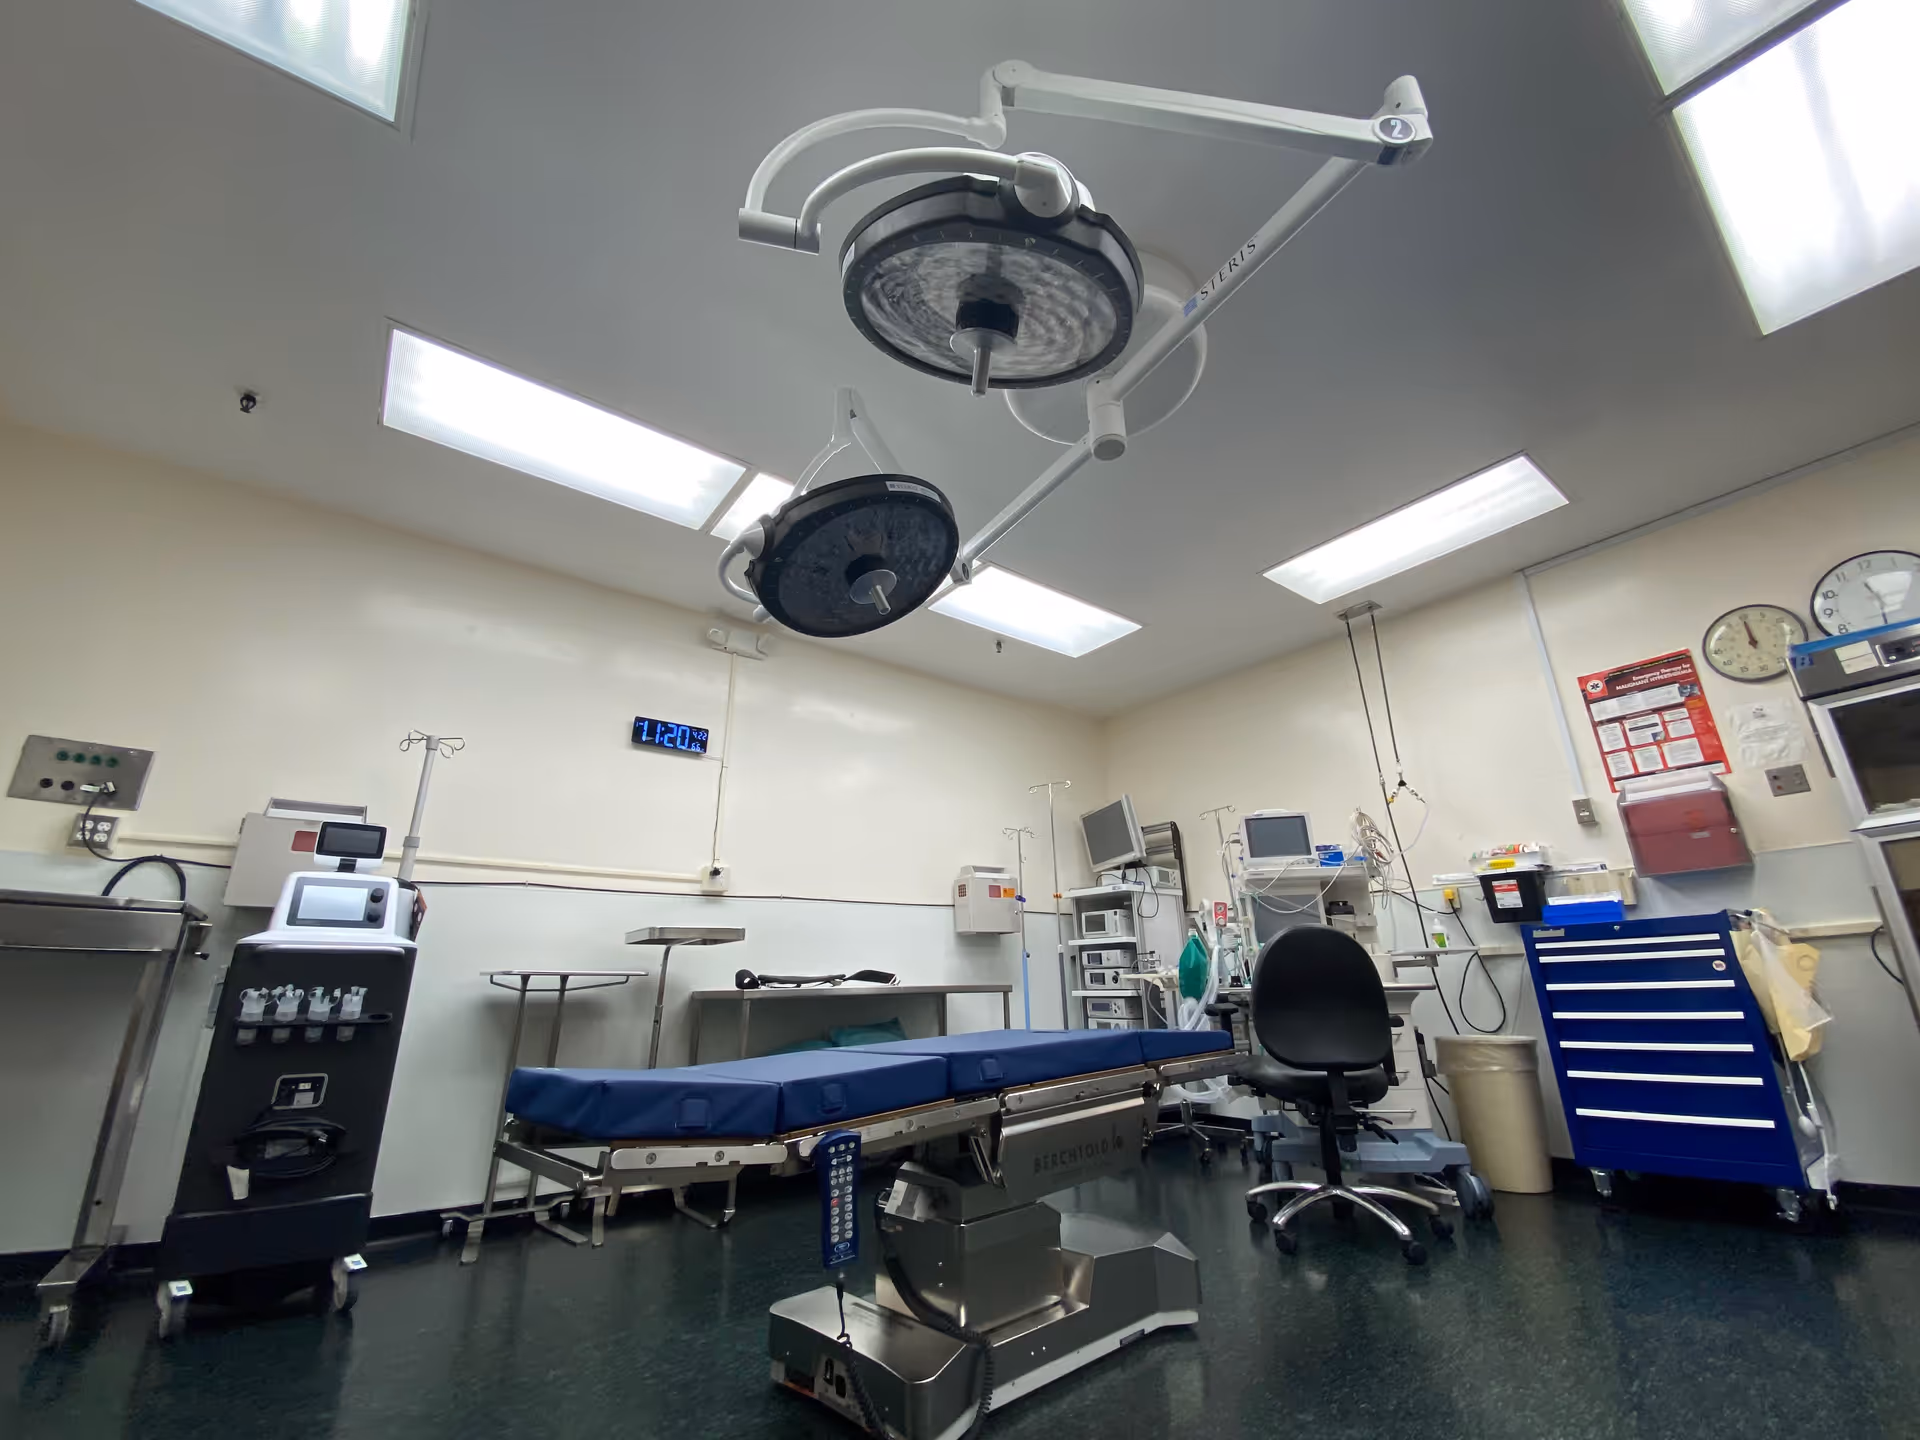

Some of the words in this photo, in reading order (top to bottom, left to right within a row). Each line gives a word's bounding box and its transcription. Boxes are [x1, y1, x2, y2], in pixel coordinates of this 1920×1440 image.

[1391, 119, 1403, 138] 2
[1200, 238, 1256, 300] STERIS
[1857, 559, 1871, 570] 12
[1836, 571, 1847, 582] 11
[1822, 589, 1836, 600] 10
[1823, 607, 1834, 618] 9
[1838, 623, 1849, 634] 8
[641, 720, 690, 749] 11:20
